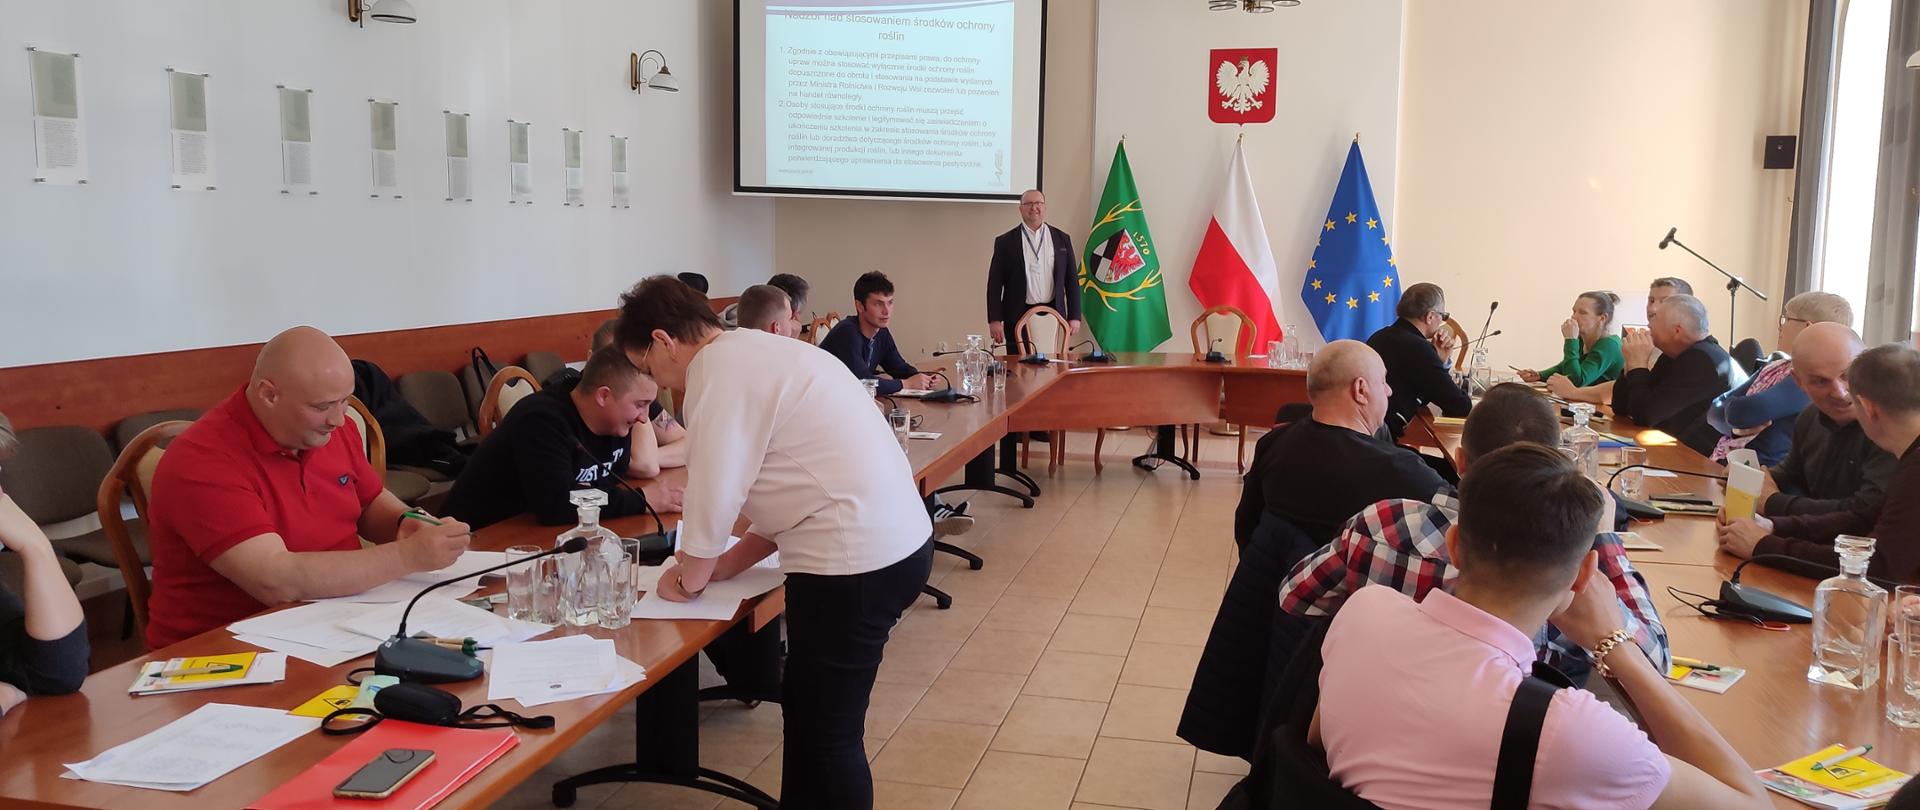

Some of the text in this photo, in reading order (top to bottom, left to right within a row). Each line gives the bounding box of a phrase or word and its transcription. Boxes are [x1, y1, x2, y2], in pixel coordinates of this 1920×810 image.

[785, 10, 995, 32] Nadzór nad stosowaniem środków ochrony
[878, 30, 904, 40] roślin
[788, 47, 816, 56] Zgodnie
[881, 52, 917, 62] przepisami
[954, 56, 981, 64] ochrony
[928, 66, 954, 74] ochrony
[786, 101, 808, 110] Osoby
[867, 105, 894, 113] ochrony
